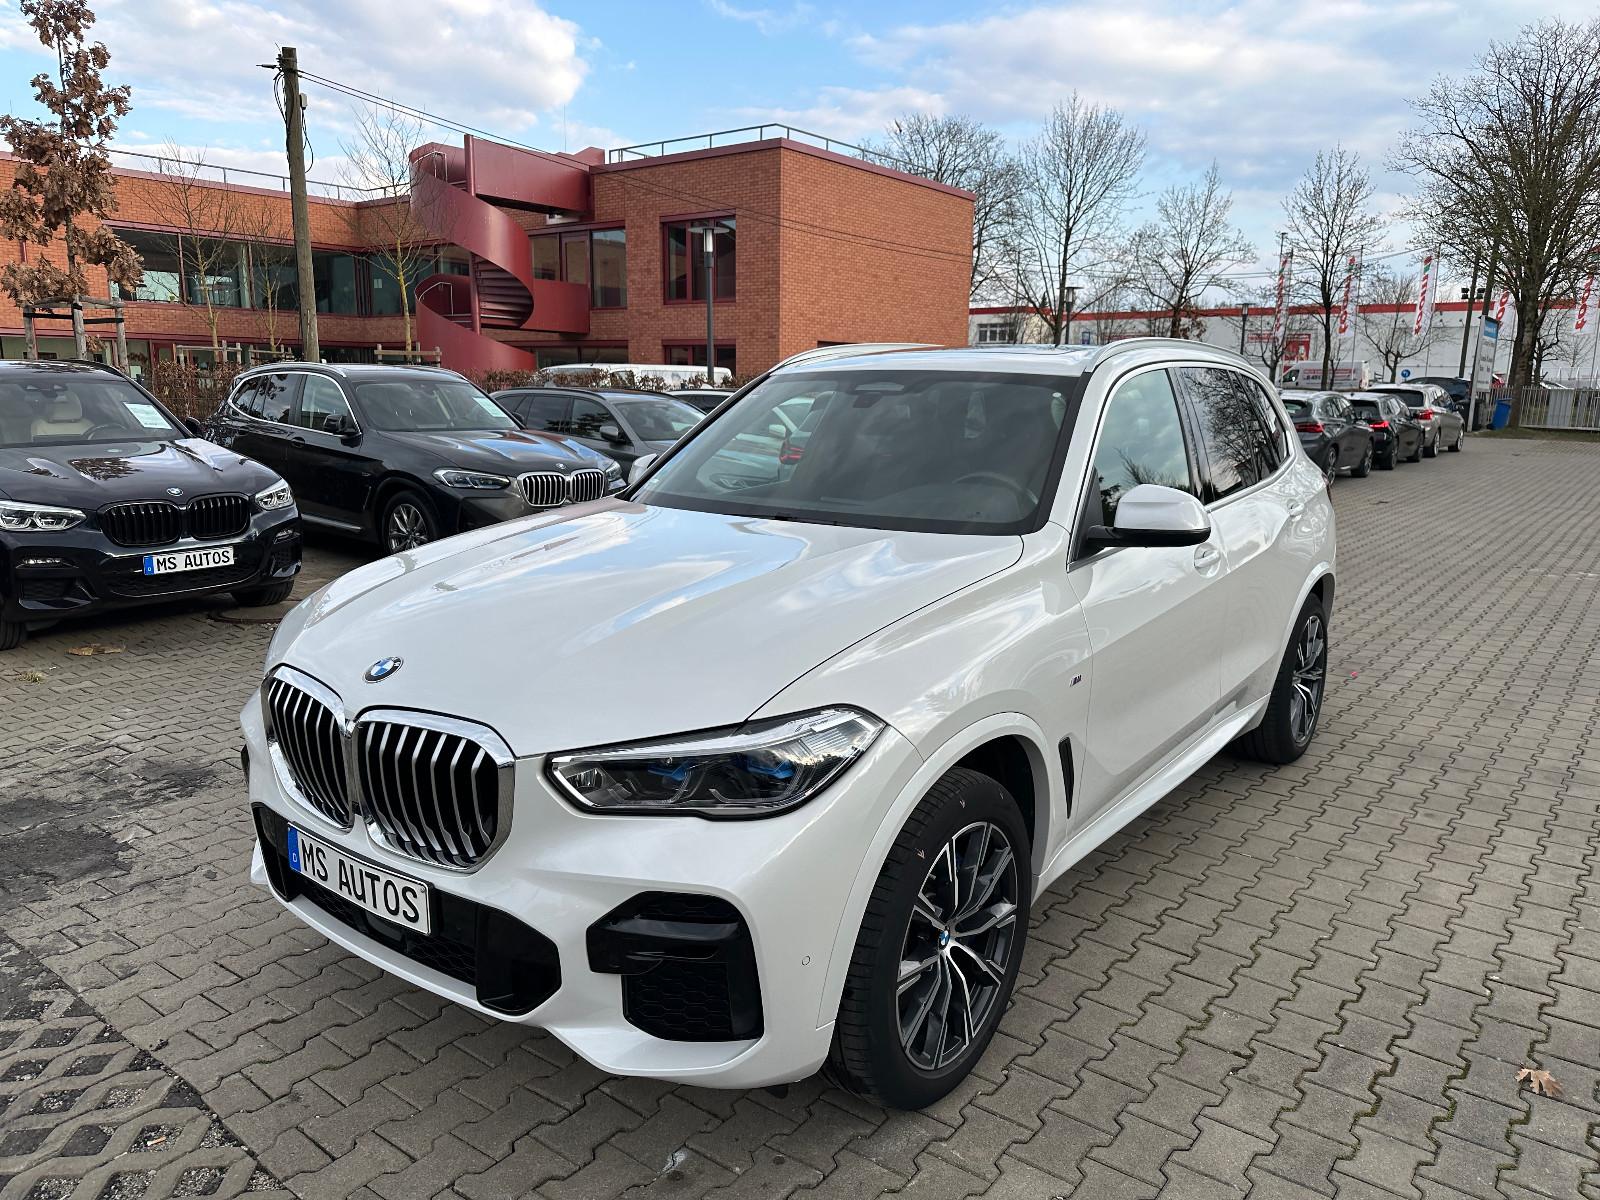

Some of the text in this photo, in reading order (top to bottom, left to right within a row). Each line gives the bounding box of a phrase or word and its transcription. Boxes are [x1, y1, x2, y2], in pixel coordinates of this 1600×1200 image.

[1415, 274, 1428, 335] toom
[156, 556, 177, 571] MS
[184, 550, 230, 568] AUTOS
[301, 838, 328, 882] MS
[338, 858, 420, 923] AUTOS
